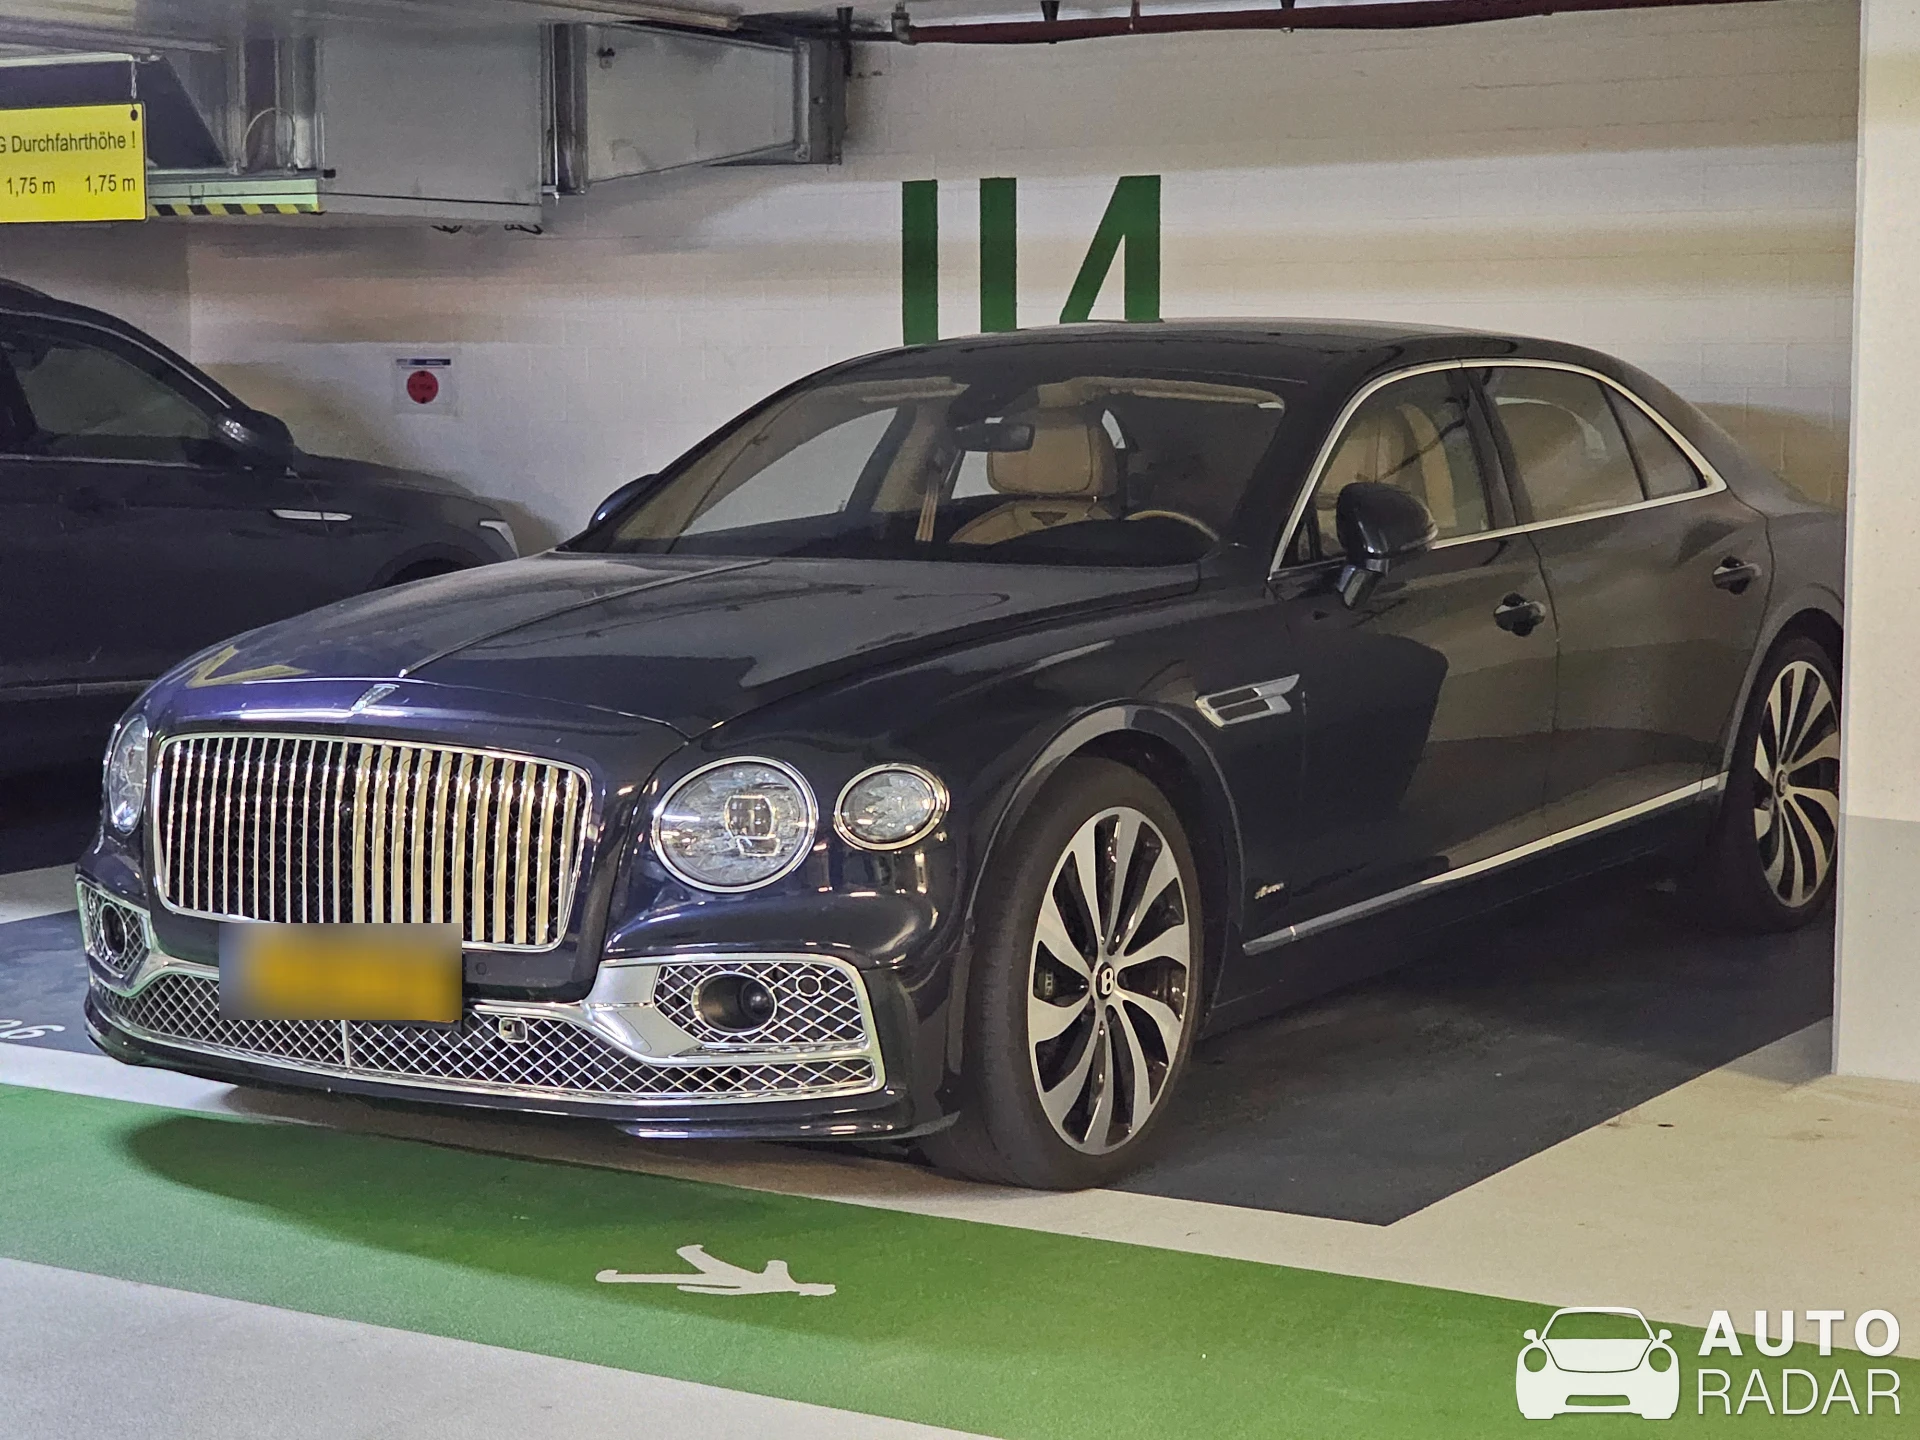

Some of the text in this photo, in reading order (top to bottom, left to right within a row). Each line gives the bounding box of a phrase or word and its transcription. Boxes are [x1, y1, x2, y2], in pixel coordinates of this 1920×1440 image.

[12, 132, 126, 153] Durchfahrthöhe
[6, 177, 56, 197] 1,75 m
[85, 174, 136, 195] 1,75 m
